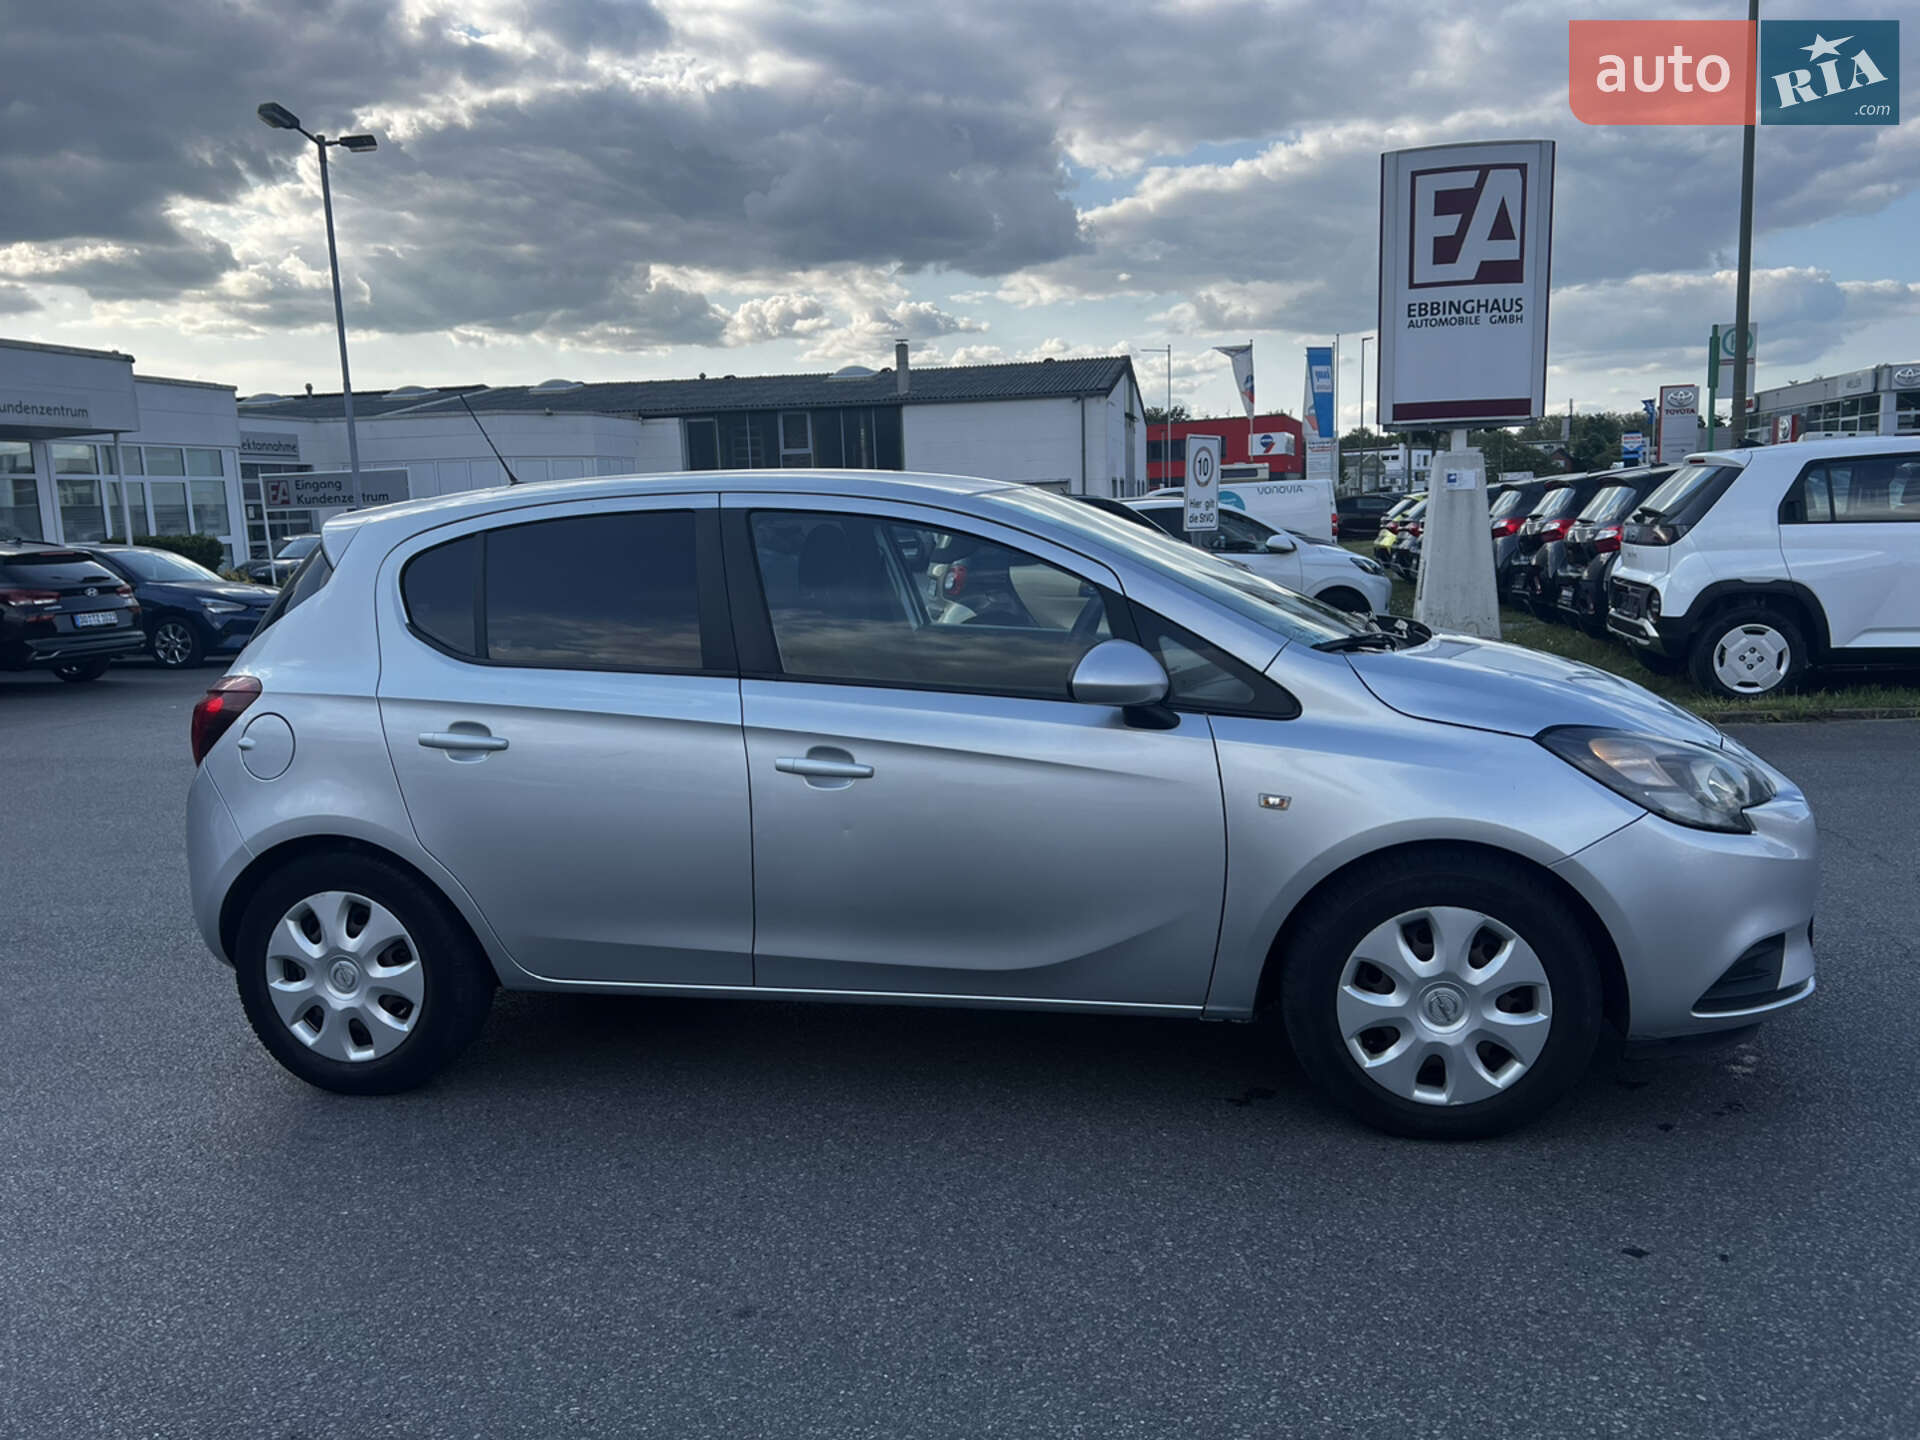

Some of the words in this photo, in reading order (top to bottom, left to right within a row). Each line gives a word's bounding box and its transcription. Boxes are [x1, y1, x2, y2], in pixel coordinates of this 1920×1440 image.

[1407, 297, 1524, 318] EBBINGHAUS
[1407, 315, 1480, 329] AUTOMOBILE
[1489, 313, 1524, 325] GMBH
[0, 400, 89, 418] undenzentrum
[1198, 457, 1209, 477] 10
[295, 480, 342, 492] Eingang
[296, 492, 390, 505] Kundenzetrum
